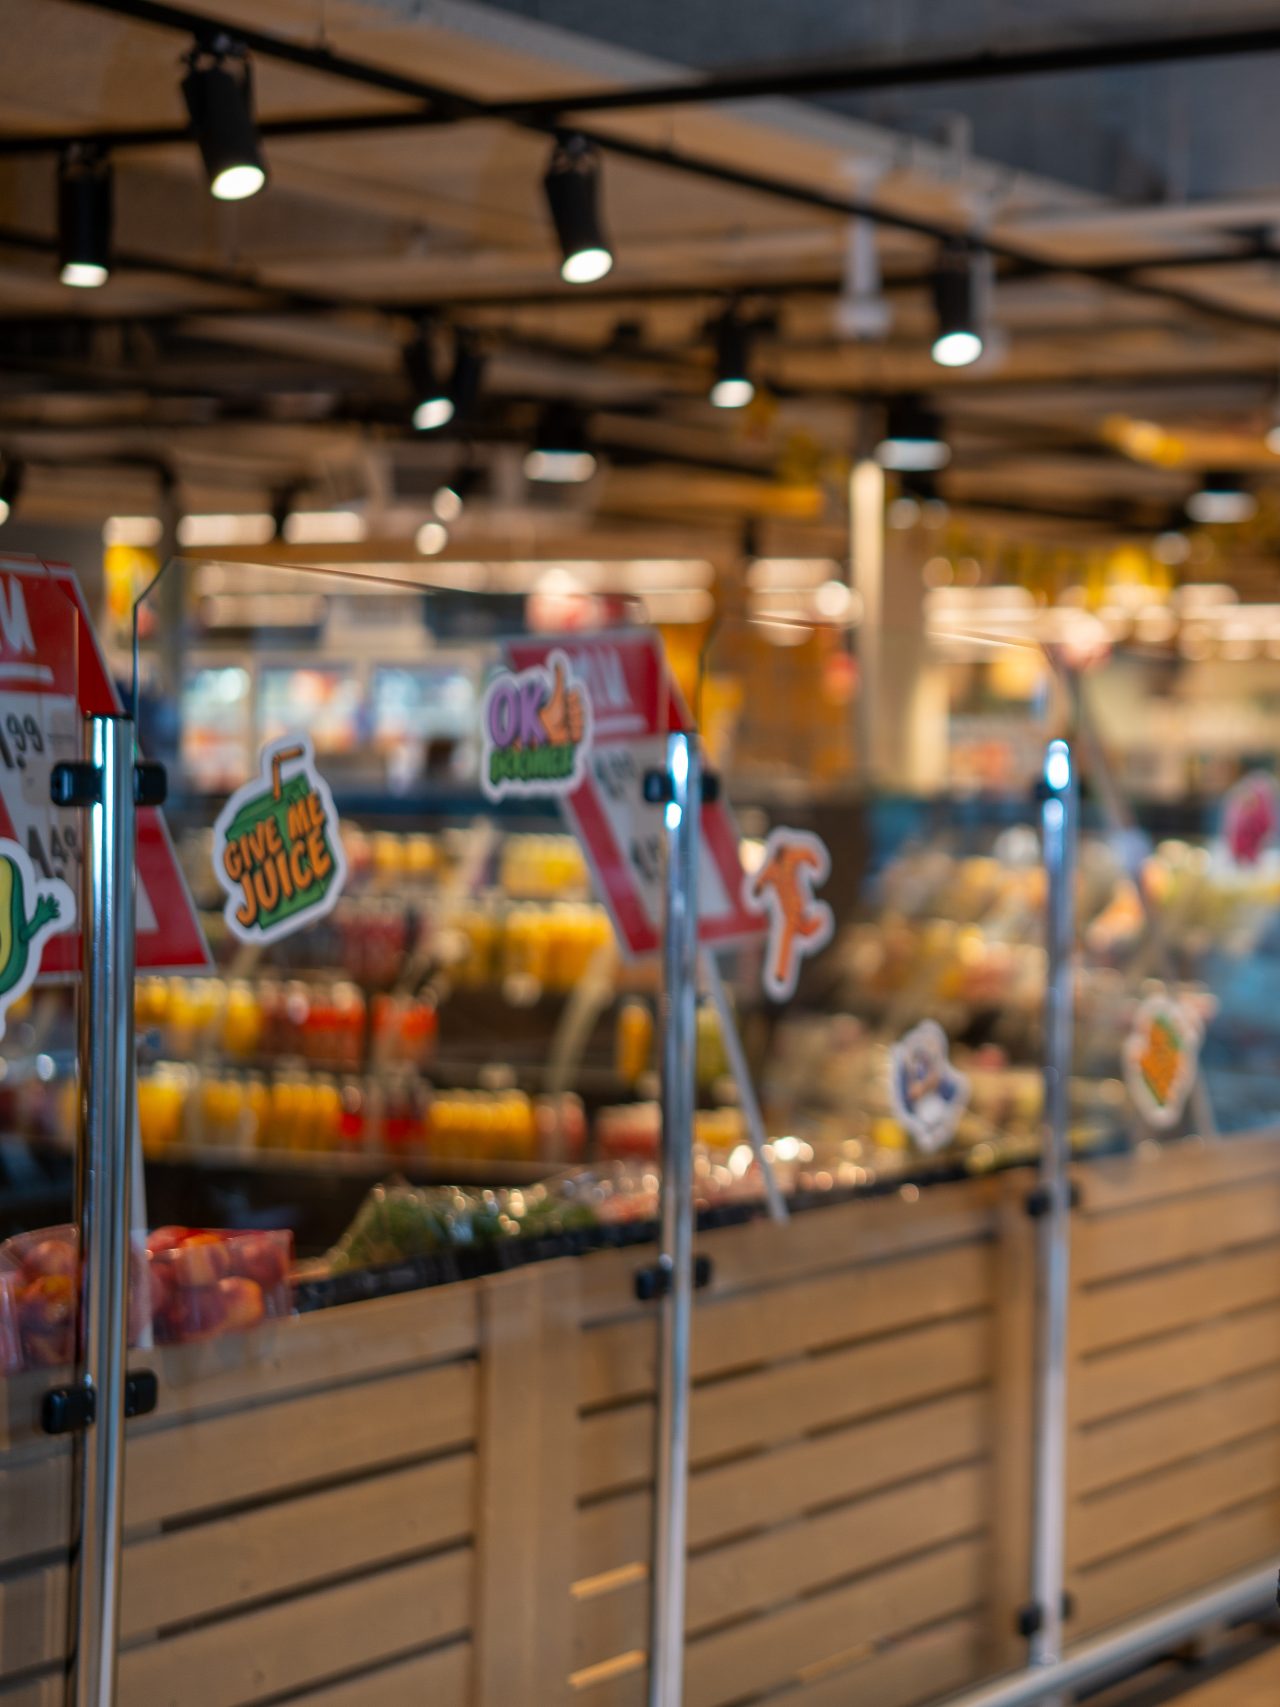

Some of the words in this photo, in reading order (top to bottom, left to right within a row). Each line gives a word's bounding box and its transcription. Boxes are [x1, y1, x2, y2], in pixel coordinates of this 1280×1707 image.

[490, 683, 547, 748] OK
[223, 815, 283, 882] GIVE
[287, 792, 326, 851] ME
[236, 825, 332, 927] JUICE
